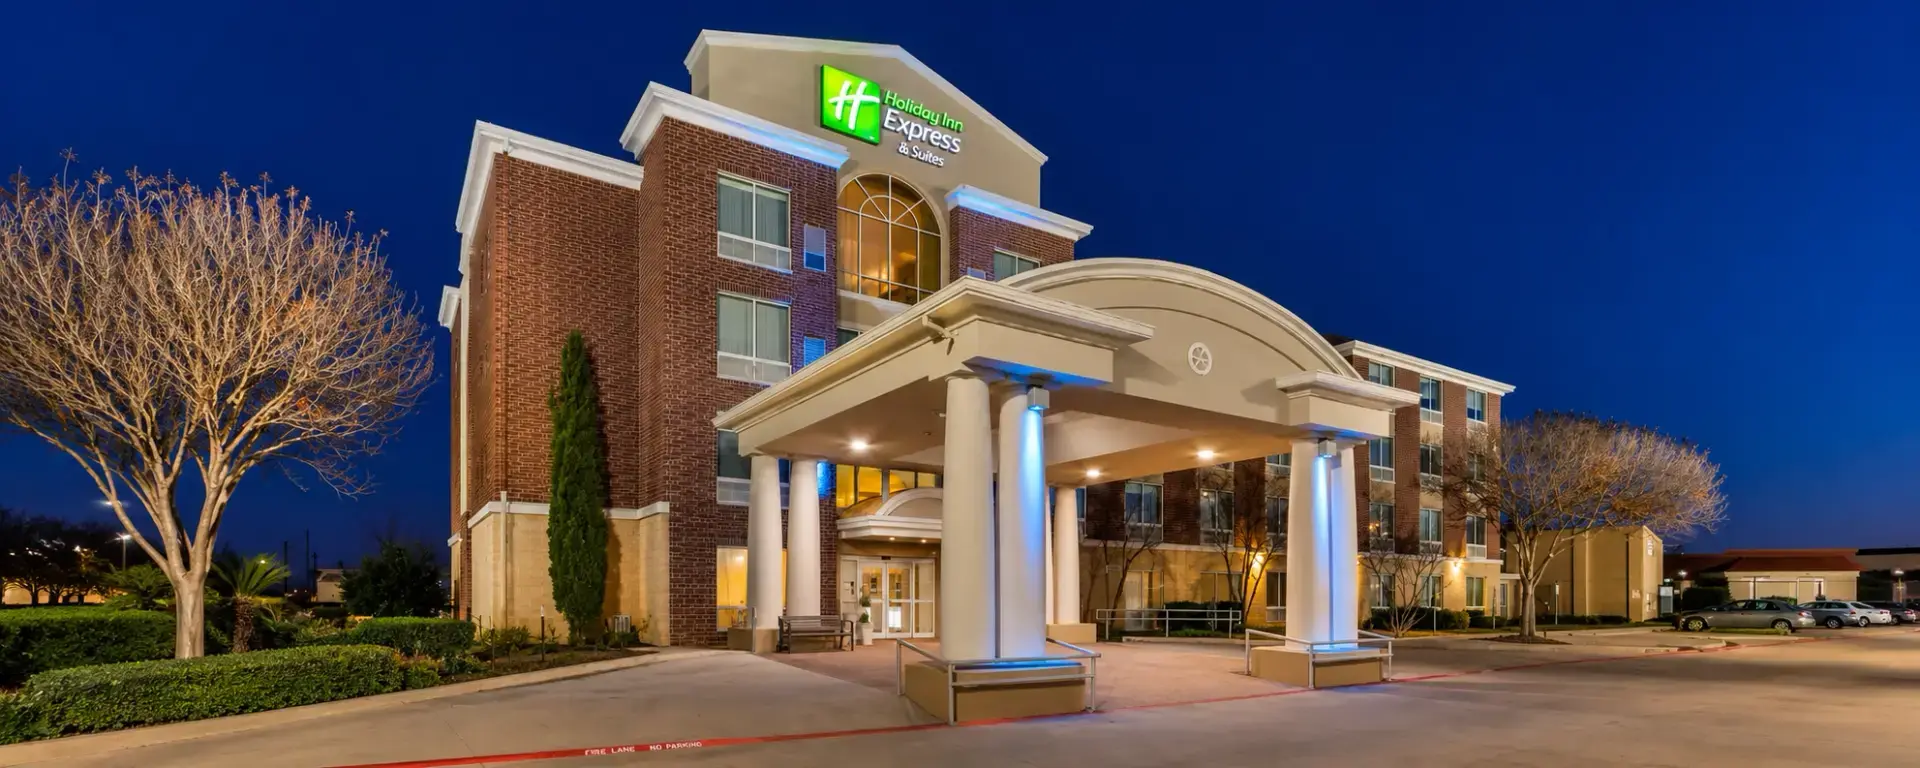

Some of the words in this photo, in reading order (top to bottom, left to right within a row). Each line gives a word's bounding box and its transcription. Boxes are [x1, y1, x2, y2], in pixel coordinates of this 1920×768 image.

[828, 80, 881, 131] H
[884, 90, 940, 126] Holiday
[942, 112, 964, 132] Inn
[883, 107, 961, 153] Express
[898, 141, 909, 155] &
[911, 145, 944, 167] Suites
[584, 748, 606, 756] FIRE
[611, 745, 635, 754] LANE
[665, 741, 702, 750] PARKING
